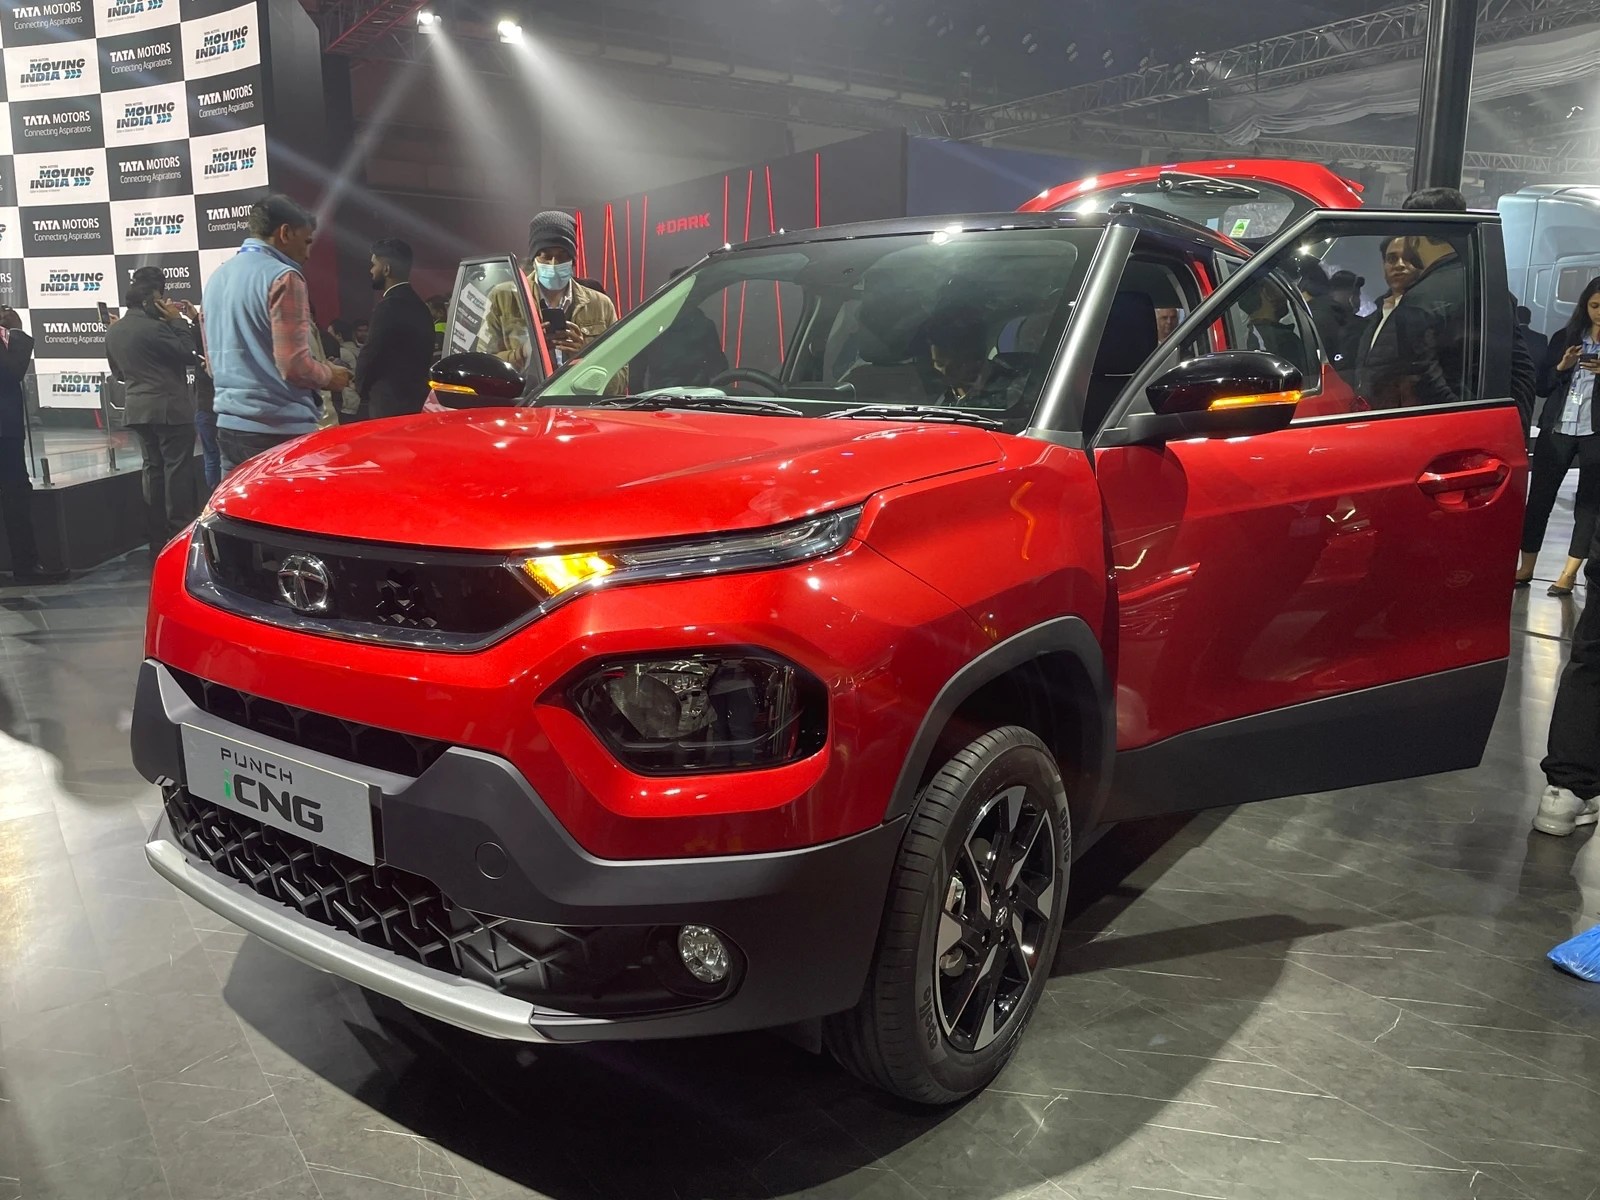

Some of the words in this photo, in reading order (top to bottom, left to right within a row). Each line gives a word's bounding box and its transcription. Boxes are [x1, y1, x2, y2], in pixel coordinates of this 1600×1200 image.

[13, 6, 41, 18] TATA
[43, 1, 82, 15] MOTORS
[108, 3, 144, 18] INDIA
[14, 20, 48, 30] Connecting
[49, 16, 83, 28] Aspirations
[204, 26, 248, 47] MOVING
[110, 49, 135, 62] TATA
[137, 42, 171, 59] MOTORS
[196, 43, 229, 59] INDIA
[30, 58, 85, 73] MOVING
[111, 63, 142, 74] Connecting
[143, 58, 172, 70] Aspirations
[20, 71, 60, 83] INDIA
[198, 92, 221, 106] TATA
[223, 84, 253, 101] MOTORS
[125, 102, 175, 117] MOVING
[199, 106, 228, 118] Connecting
[228, 101, 254, 113] Aspirations
[23, 115, 51, 126] TATA
[53, 110, 90, 124] MOTORS
[116, 116, 153, 128] INDIA
[24, 128, 58, 137] Connecting
[59, 126, 92, 135] Aspirations
[213, 147, 256, 163] MOVING
[119, 161, 145, 172] TATA
[147, 156, 180, 170] MOTORS
[204, 161, 238, 175] INDIA
[39, 167, 94, 179] MOVING
[120, 174, 151, 183] Connecting
[152, 172, 181, 181] Aspirations
[30, 178, 70, 189] INDIA
[207, 208, 230, 220] TATA
[232, 204, 253, 217] MOTO
[33, 219, 60, 231] TATA
[62, 218, 99, 230] MOTORS
[134, 214, 184, 226] MOVING
[208, 222, 236, 232] Connecting
[656, 212, 710, 236] #DARK
[34, 233, 67, 242] Connecting
[68, 232, 101, 241] Aspirations
[126, 226, 162, 237] INDIA
[50, 272, 103, 282] MOVING
[163, 267, 190, 279] OTORS
[40, 282, 79, 292] INDIA
[164, 281, 191, 291] spirations
[43, 323, 71, 333] TATA
[44, 335, 78, 345] Connecting
[52, 384, 90, 392] INDIA
[221, 747, 293, 785] PUNCH
[223, 768, 324, 833] iCNG
[1059, 806, 1070, 863] apollo
[919, 985, 938, 1050] apollo
